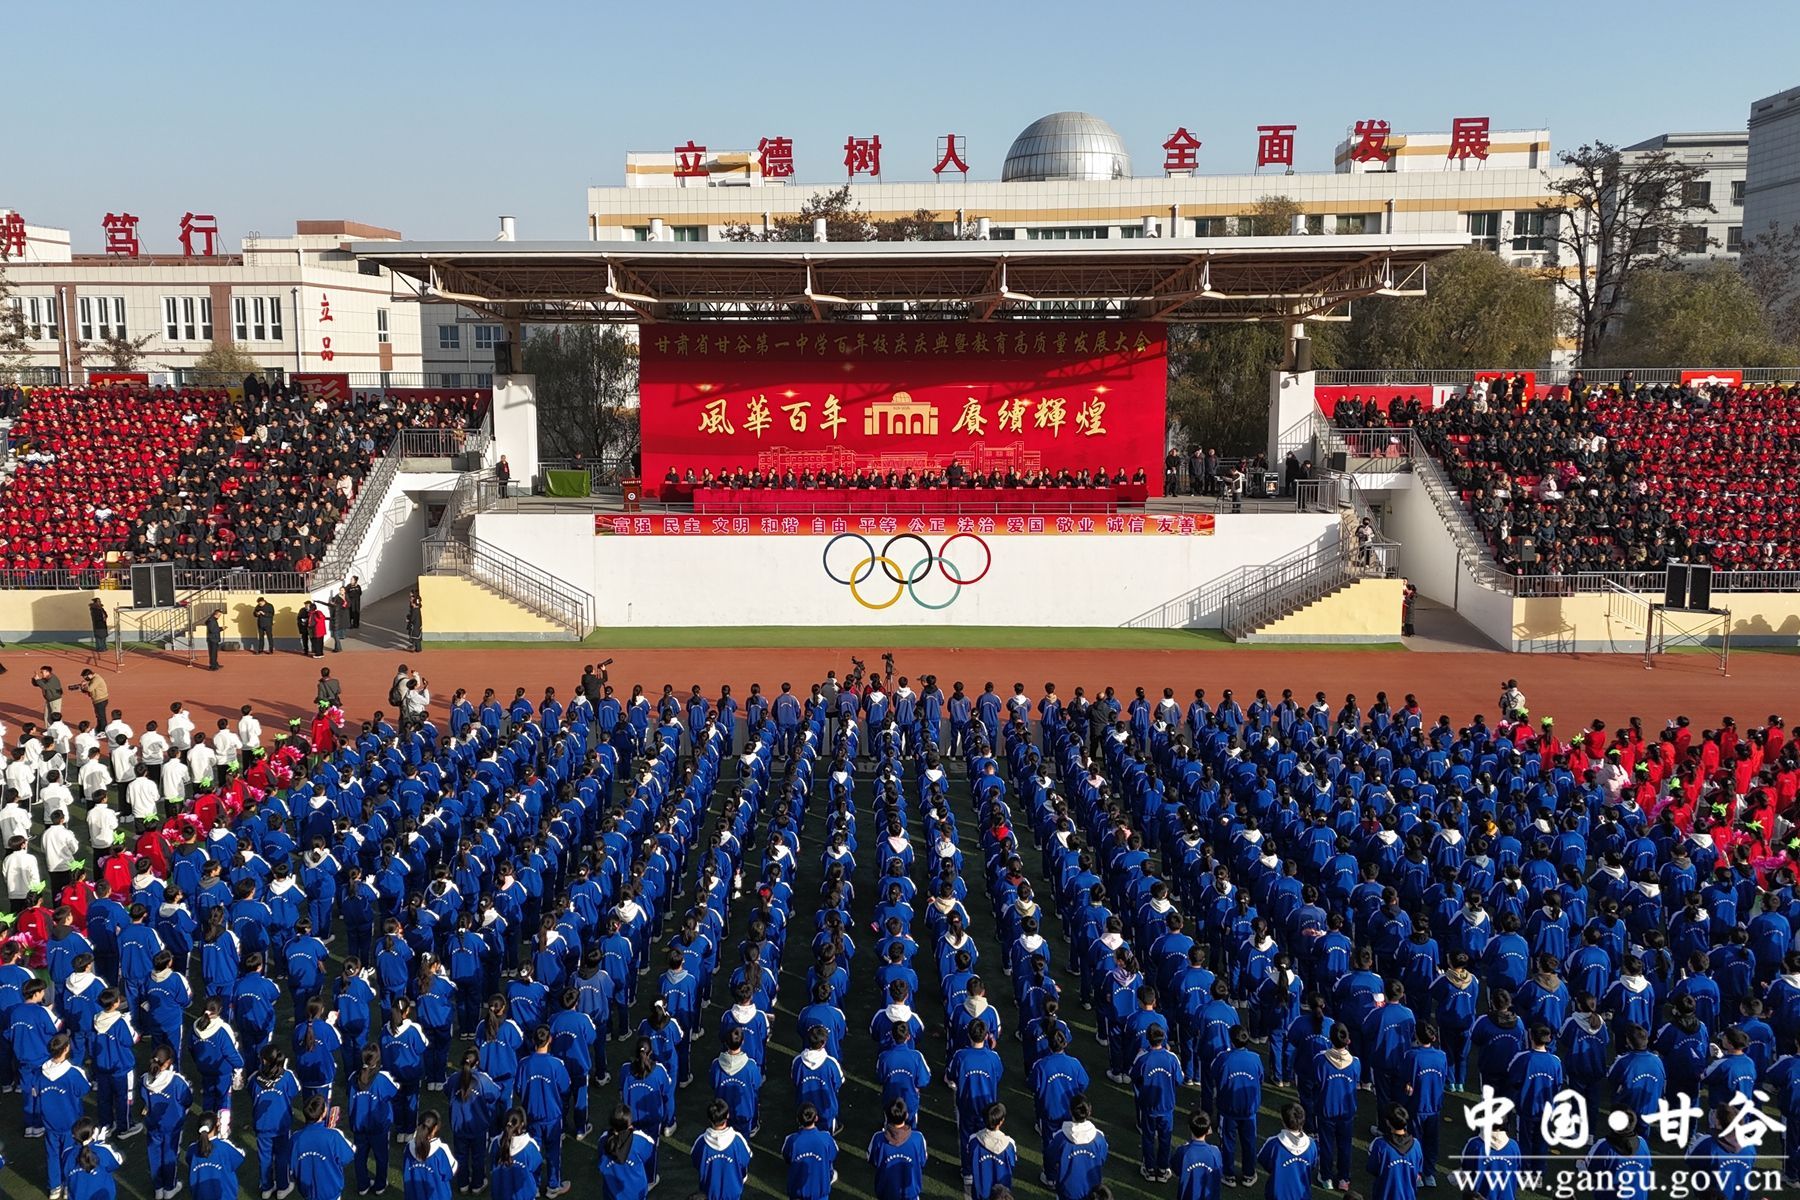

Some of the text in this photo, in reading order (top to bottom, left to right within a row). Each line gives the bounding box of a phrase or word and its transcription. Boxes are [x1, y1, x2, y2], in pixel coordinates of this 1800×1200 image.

[673, 117, 1490, 178] 立德树人 全面发展
[102, 212, 218, 257] 笃行
[319, 292, 334, 361] 立品
[698, 393, 848, 439] 風華百年
[613, 517, 1196, 534] 富强 民主 文明 和谐 自由 平等 公正 法治 爱国 敬业 诚信 友善
